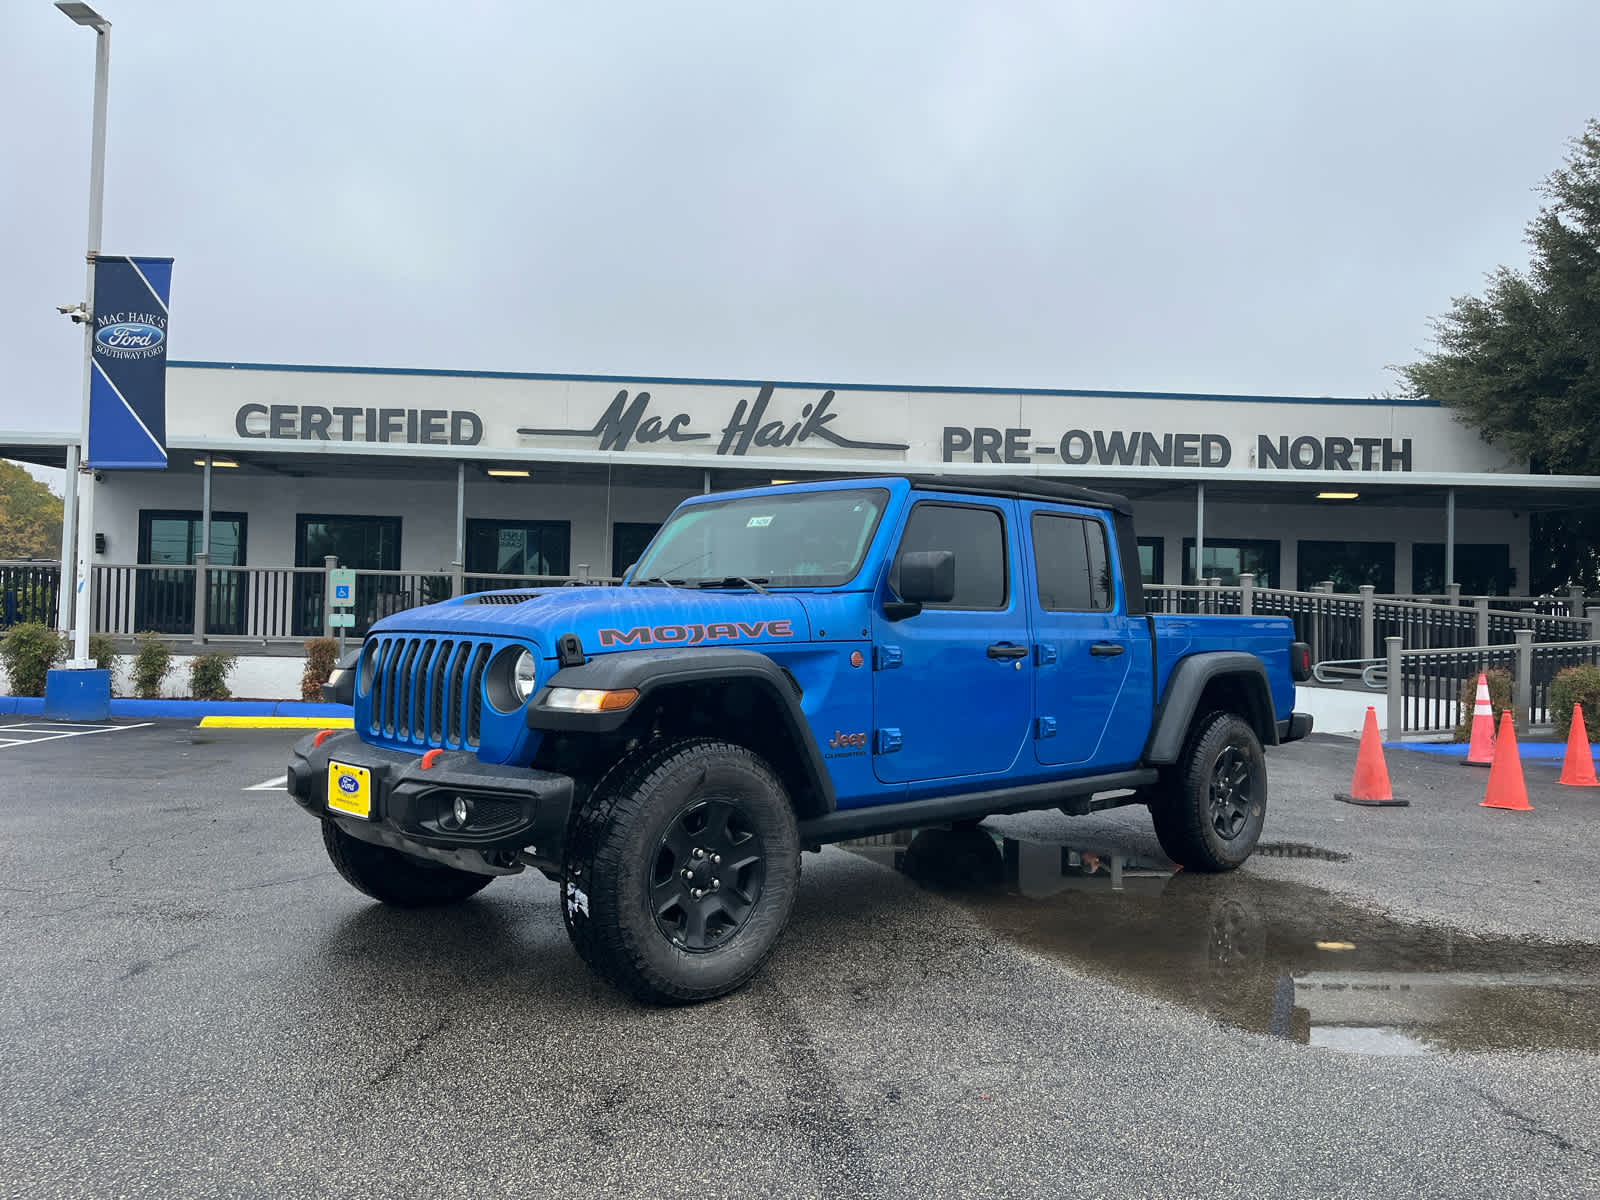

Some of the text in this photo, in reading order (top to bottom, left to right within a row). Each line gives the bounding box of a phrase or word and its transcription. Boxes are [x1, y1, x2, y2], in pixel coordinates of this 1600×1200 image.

[97, 312, 166, 329] MAC HAIK'S
[108, 326, 152, 346] Ford
[96, 345, 164, 360] SOUTHWAY FORD
[235, 382, 1412, 472] CERTIFIED Mac Haik PRE-OWNED NORTH
[599, 620, 793, 646] MOJAVE
[828, 730, 866, 749] Jeep
[342, 776, 356, 791] Ford
